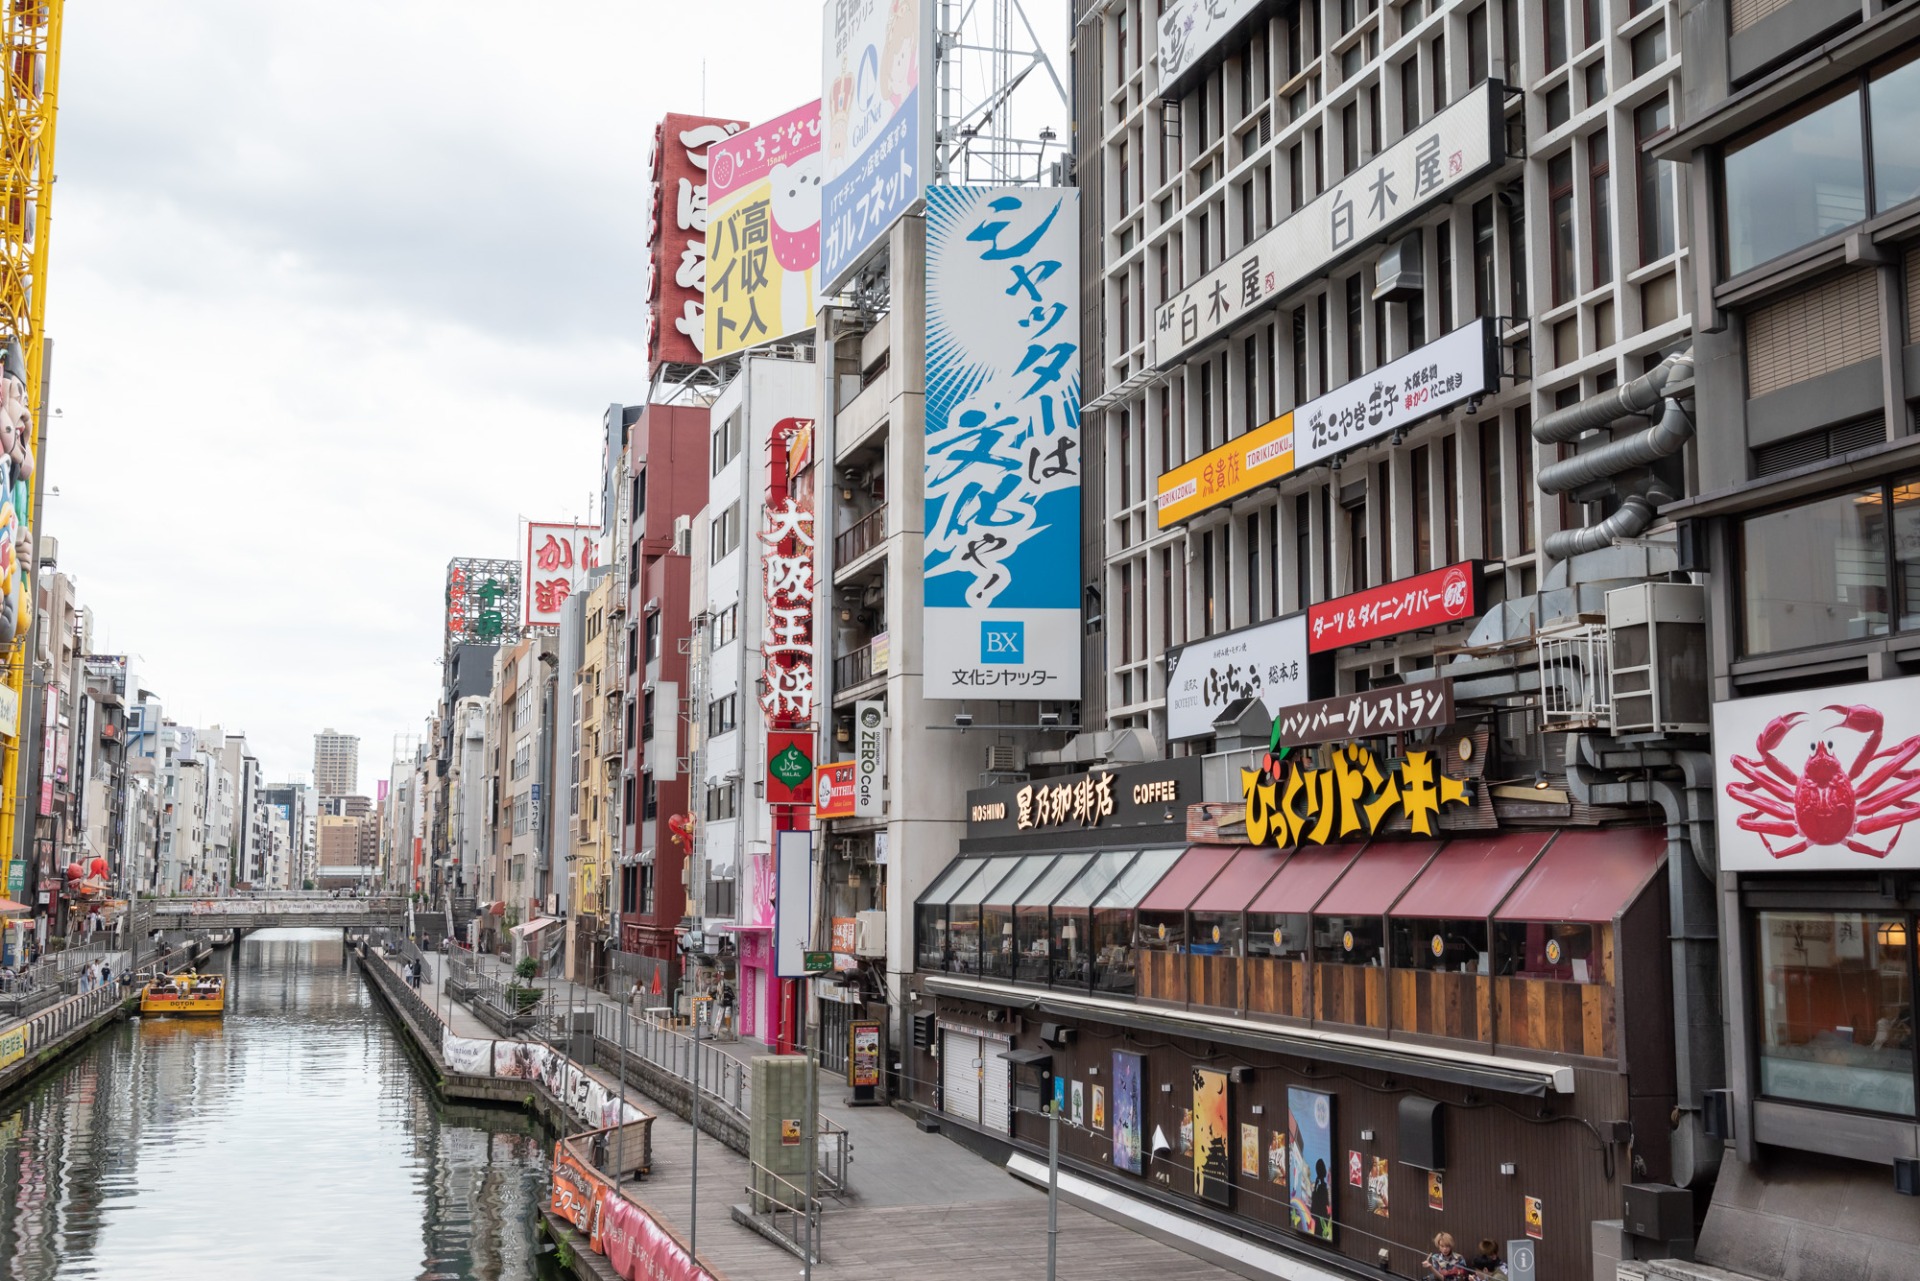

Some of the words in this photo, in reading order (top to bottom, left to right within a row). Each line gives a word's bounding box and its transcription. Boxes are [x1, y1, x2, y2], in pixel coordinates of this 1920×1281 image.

[766, 151, 788, 168] 15navi
[825, 148, 914, 274] ガルフネット
[1330, 133, 1444, 252] 白木屋
[711, 209, 741, 350] バイト
[739, 199, 770, 342] 高収入
[1159, 302, 1176, 332] 4F
[1182, 255, 1262, 347] 白木屋
[1404, 363, 1438, 393] 大阪名物
[1405, 387, 1429, 411] 串かつ
[1312, 383, 1399, 449] たこやき王子
[1203, 451, 1240, 497] 鳥貴族
[1247, 437, 1289, 467] TORIKIZOKU
[761, 498, 815, 719] 大阪王将
[1313, 611, 1344, 640] ダーツ
[1347, 608, 1356, 630] &
[1358, 587, 1441, 628] ダイニングバー
[986, 632, 1020, 653] BX
[1167, 656, 1178, 672] 2F
[1203, 663, 1262, 708] ぼてぢゅう
[1268, 660, 1299, 686] 総本店
[1281, 689, 1444, 739] ハンバーグレストラン
[779, 758, 802, 771] حلال
[861, 730, 876, 774] ZERO
[972, 802, 1005, 822] HOSHINO
[1016, 771, 1114, 831] 星乃珈琲店
[1133, 780, 1176, 805] COFFEE
[1240, 742, 1470, 850] びっくりドンキー
